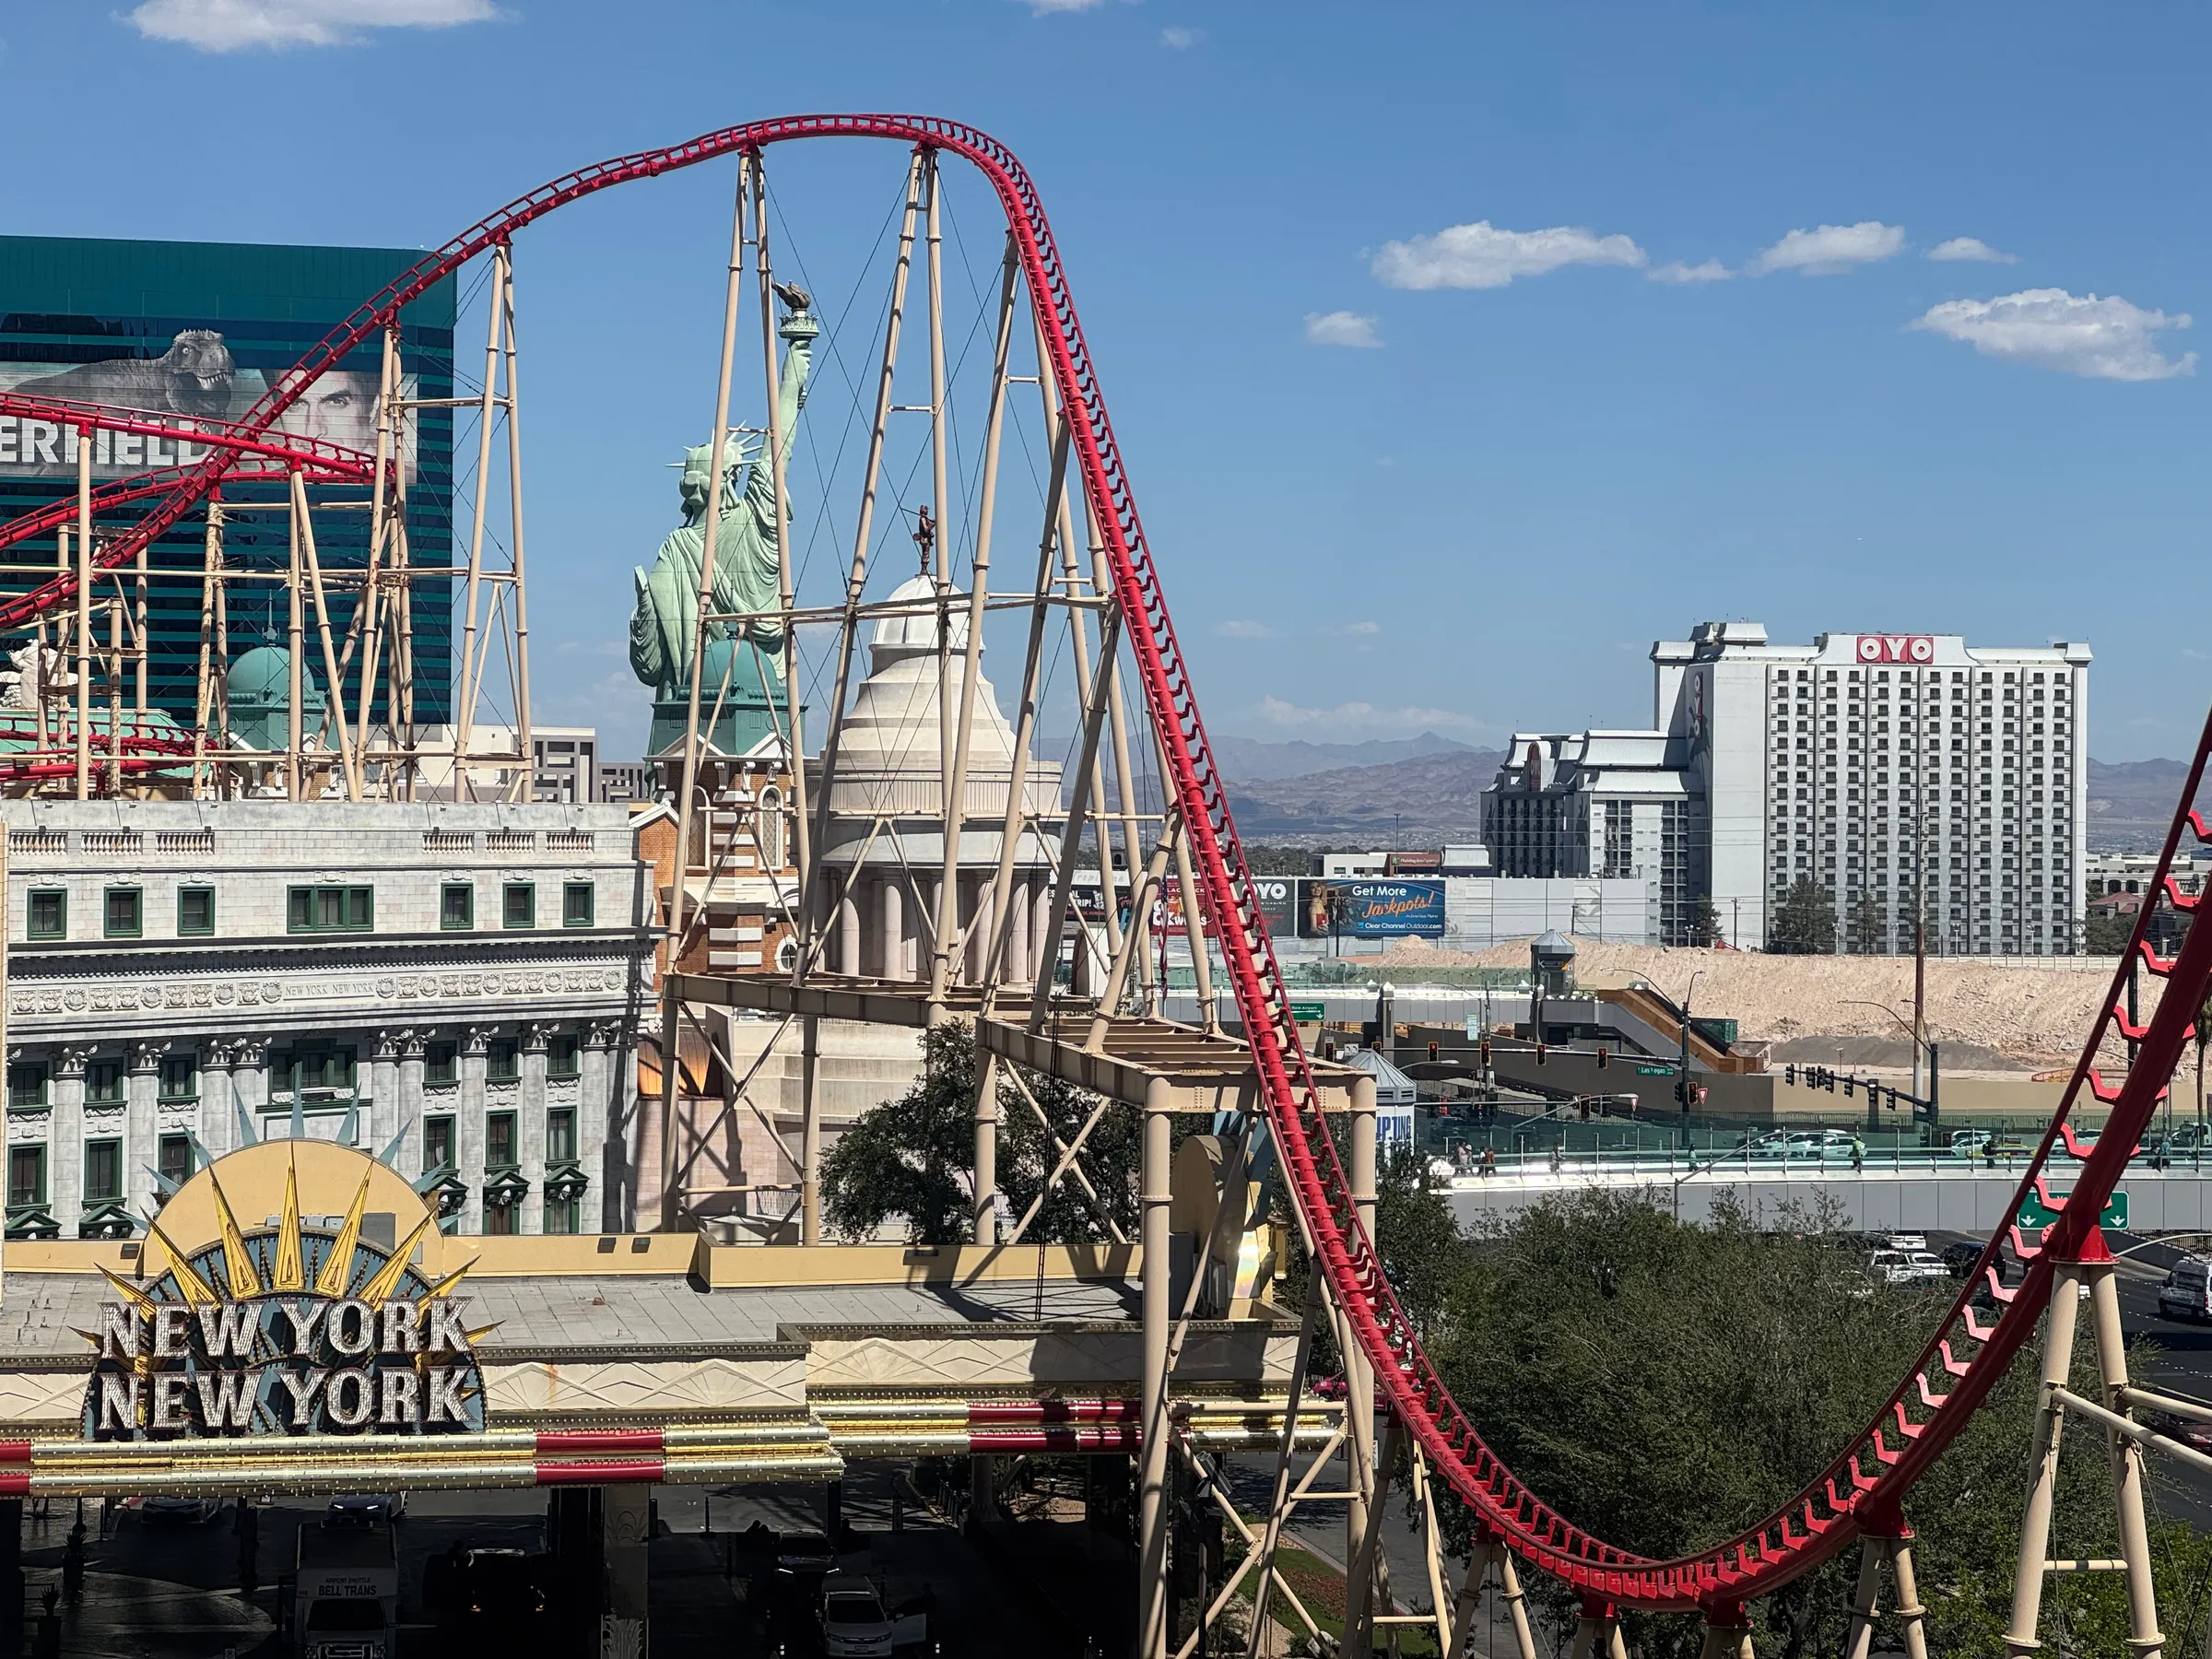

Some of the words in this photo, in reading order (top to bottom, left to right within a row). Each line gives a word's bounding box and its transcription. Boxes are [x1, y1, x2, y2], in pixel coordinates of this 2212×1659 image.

[1860, 638, 1932, 661] OYO
[1242, 883, 1287, 900] OYO
[1352, 886, 1374, 896] Get
[1377, 886, 1407, 896] More
[1362, 890, 1435, 918] Jackpots!
[286, 985, 303, 996] NEW
[306, 984, 328, 995] YORK
[332, 983, 350, 994] NEW
[352, 982, 373, 994] YORK
[98, 1300, 267, 1359] NEW
[279, 1296, 475, 1356] YORK
[97, 1369, 265, 1430] NEW
[277, 1366, 477, 1427] YORK
[318, 1584, 341, 1596] BELL
[344, 1584, 377, 1596] TRANS
